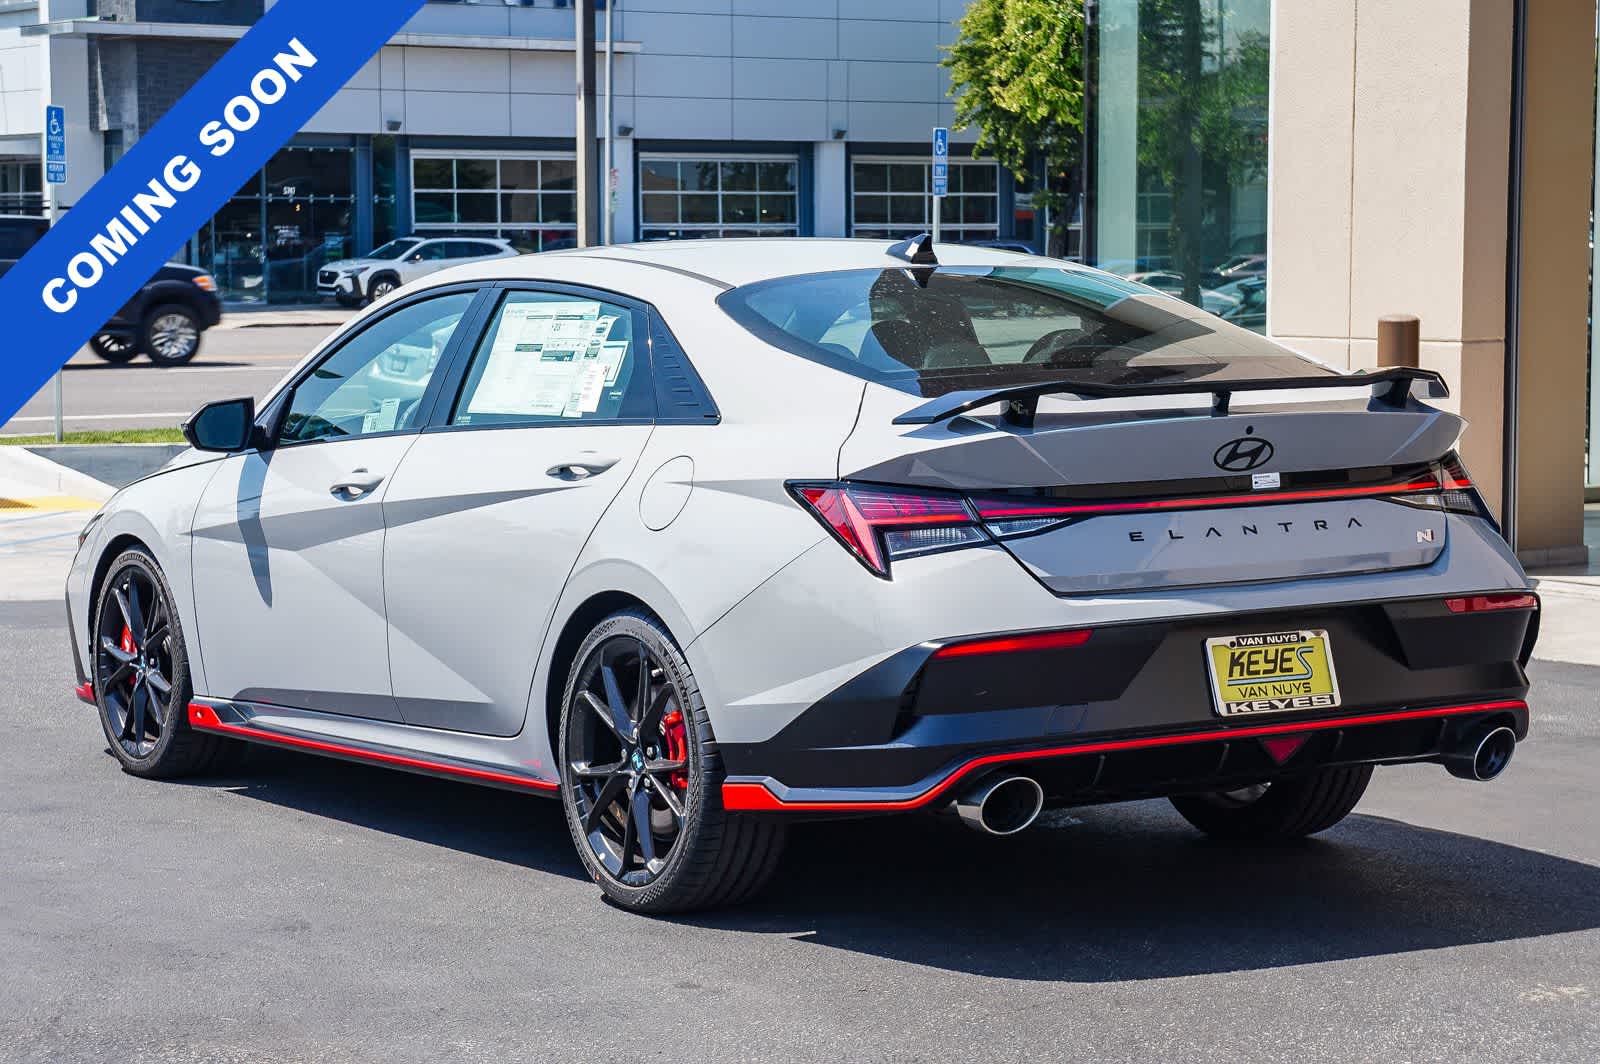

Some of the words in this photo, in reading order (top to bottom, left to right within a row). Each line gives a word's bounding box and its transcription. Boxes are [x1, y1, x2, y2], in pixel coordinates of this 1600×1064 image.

[1128, 516, 1363, 543] ELANTRA
[1416, 528, 1434, 544] N
[1238, 637, 1264, 647] VAN
[1266, 634, 1298, 645] NUYS
[1227, 645, 1315, 680] KEYES
[1237, 685, 1268, 698] VAN
[1272, 682, 1312, 696] NUYS
[1229, 695, 1332, 713] KEYES
